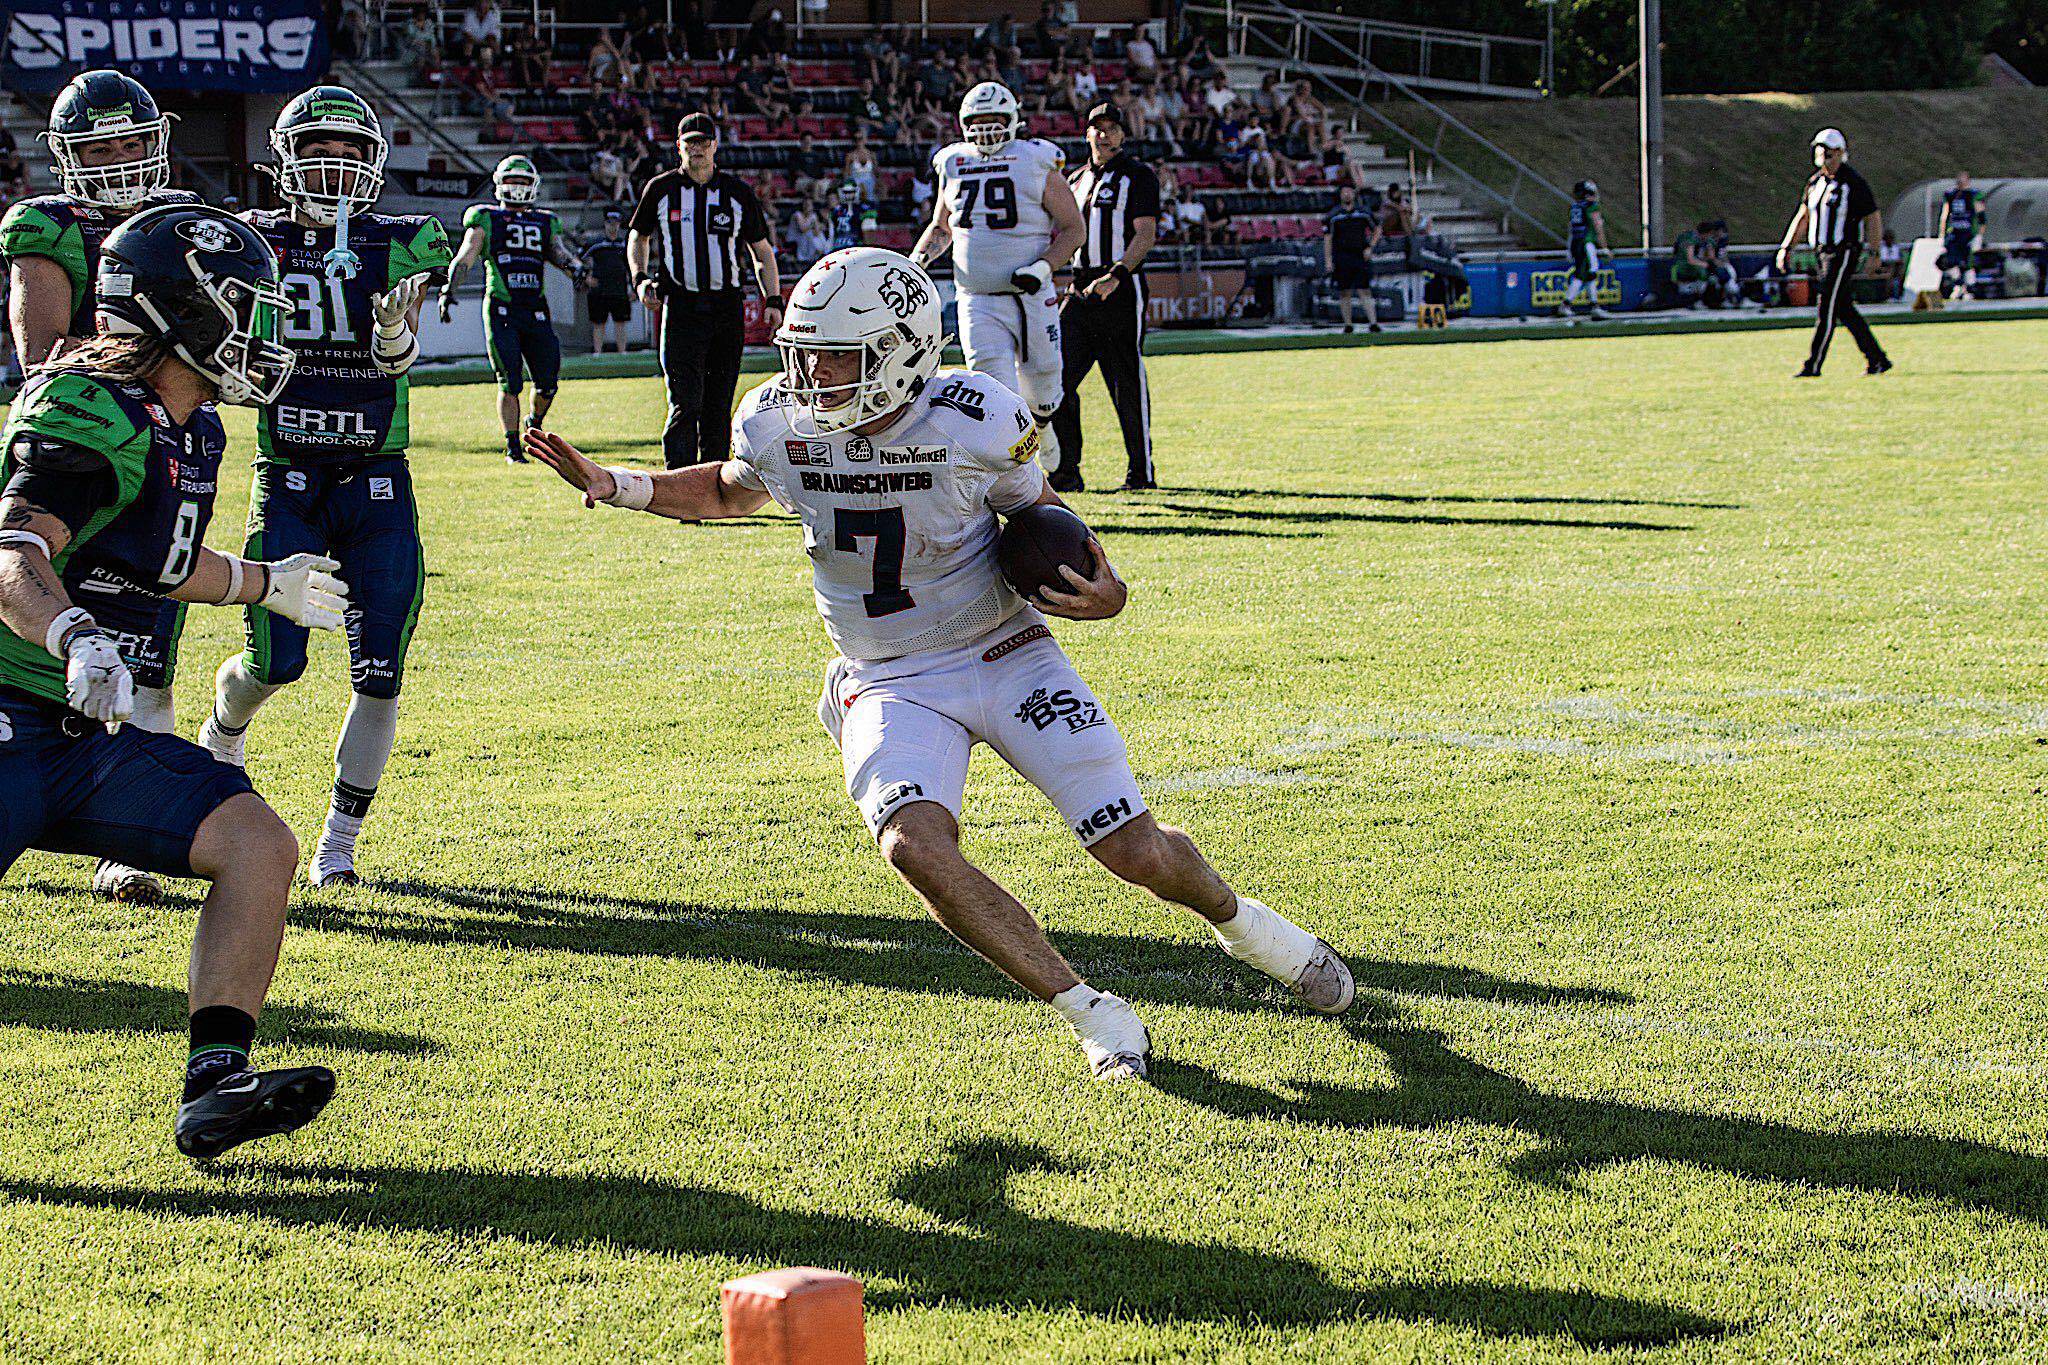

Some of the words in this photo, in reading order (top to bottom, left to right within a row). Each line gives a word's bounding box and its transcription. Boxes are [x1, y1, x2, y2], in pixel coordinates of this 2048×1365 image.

[62, 1, 264, 18] STRAUBING
[8, 12, 316, 70] SPIDERS
[80, 61, 259, 79] FOTBALL
[956, 177, 1018, 230] 79
[505, 223, 542, 252] 32
[290, 248, 326, 259] STAD
[283, 273, 357, 342] 31
[941, 380, 985, 407] dm
[276, 404, 377, 435] ERTL
[276, 430, 375, 448] TECHNOLOGY
[285, 470, 307, 491] S
[800, 471, 933, 495] BRAUNSCHWEIG
[157, 500, 199, 586] 8
[833, 505, 917, 618] 7
[1029, 689, 1082, 731] BS
[1062, 708, 1105, 732] BZ
[1074, 797, 1133, 843] HEH
